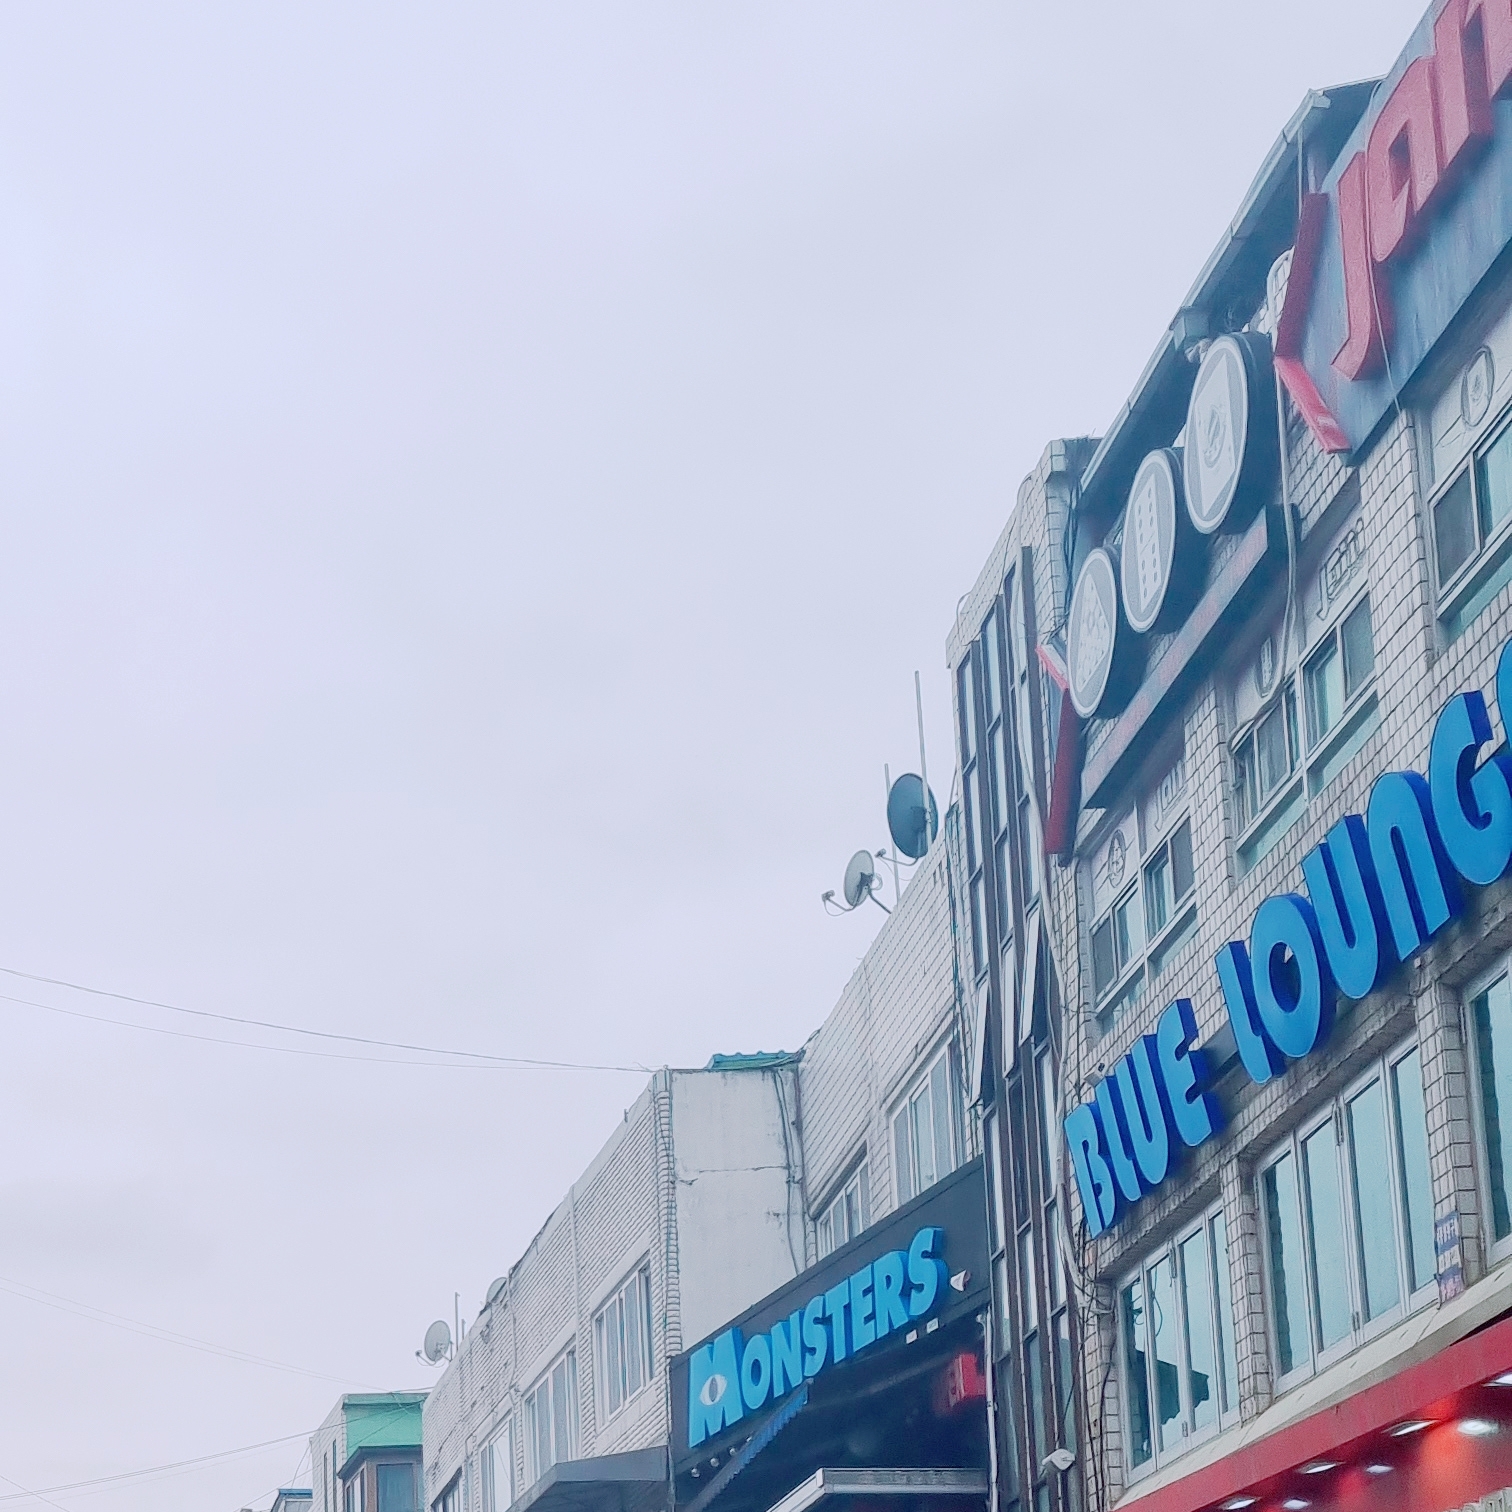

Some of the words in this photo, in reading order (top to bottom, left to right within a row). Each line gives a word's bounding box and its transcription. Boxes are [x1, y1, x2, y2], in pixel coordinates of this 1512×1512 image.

[1064, 998, 1221, 1240] BLUE
[1215, 638, 1512, 1085] LOUNG
[689, 1227, 948, 1448] MONSTERS
